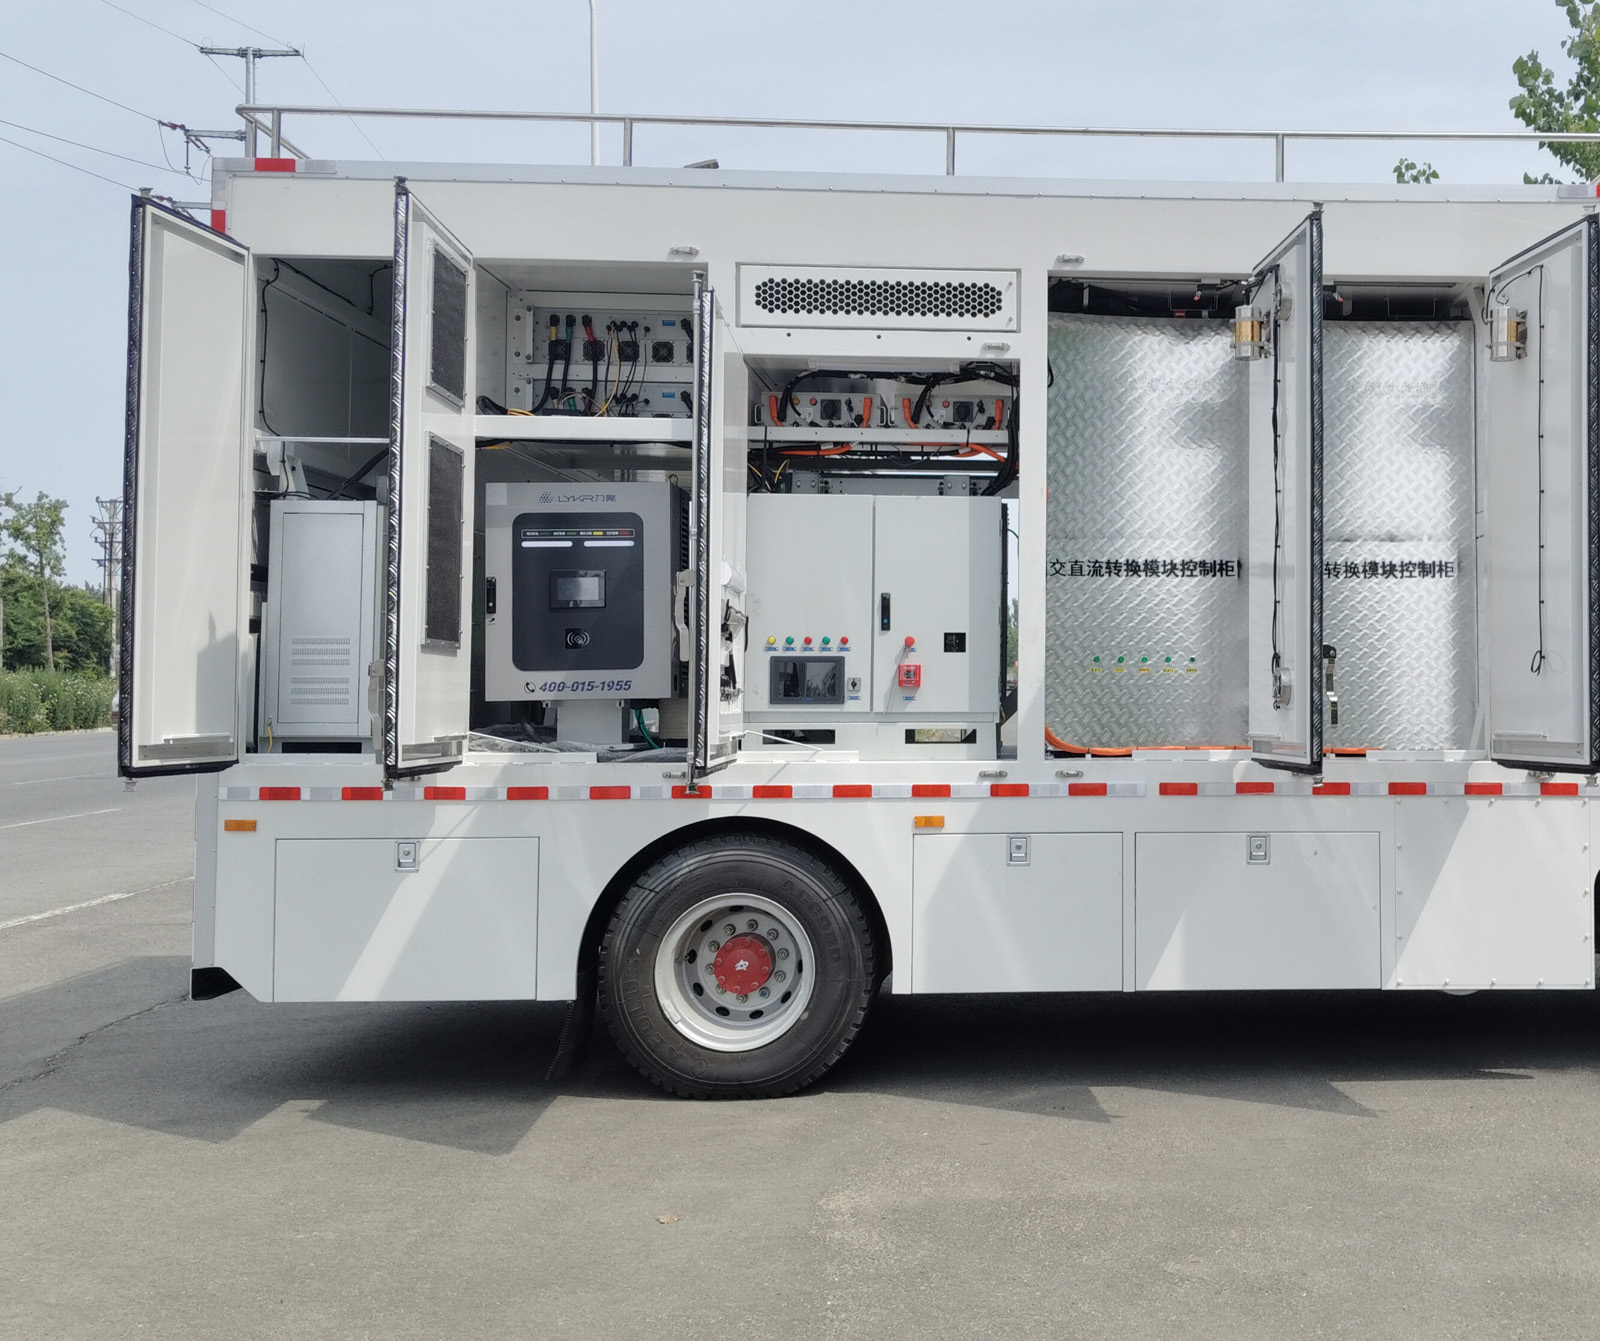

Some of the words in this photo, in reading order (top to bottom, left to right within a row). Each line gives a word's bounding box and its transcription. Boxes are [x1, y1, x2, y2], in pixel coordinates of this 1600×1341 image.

[1049, 558, 1236, 578] 交直流转换模块控制柜
[1324, 560, 1455, 579] 转换模块控制柜
[539, 680, 632, 692] 400-015-1955
